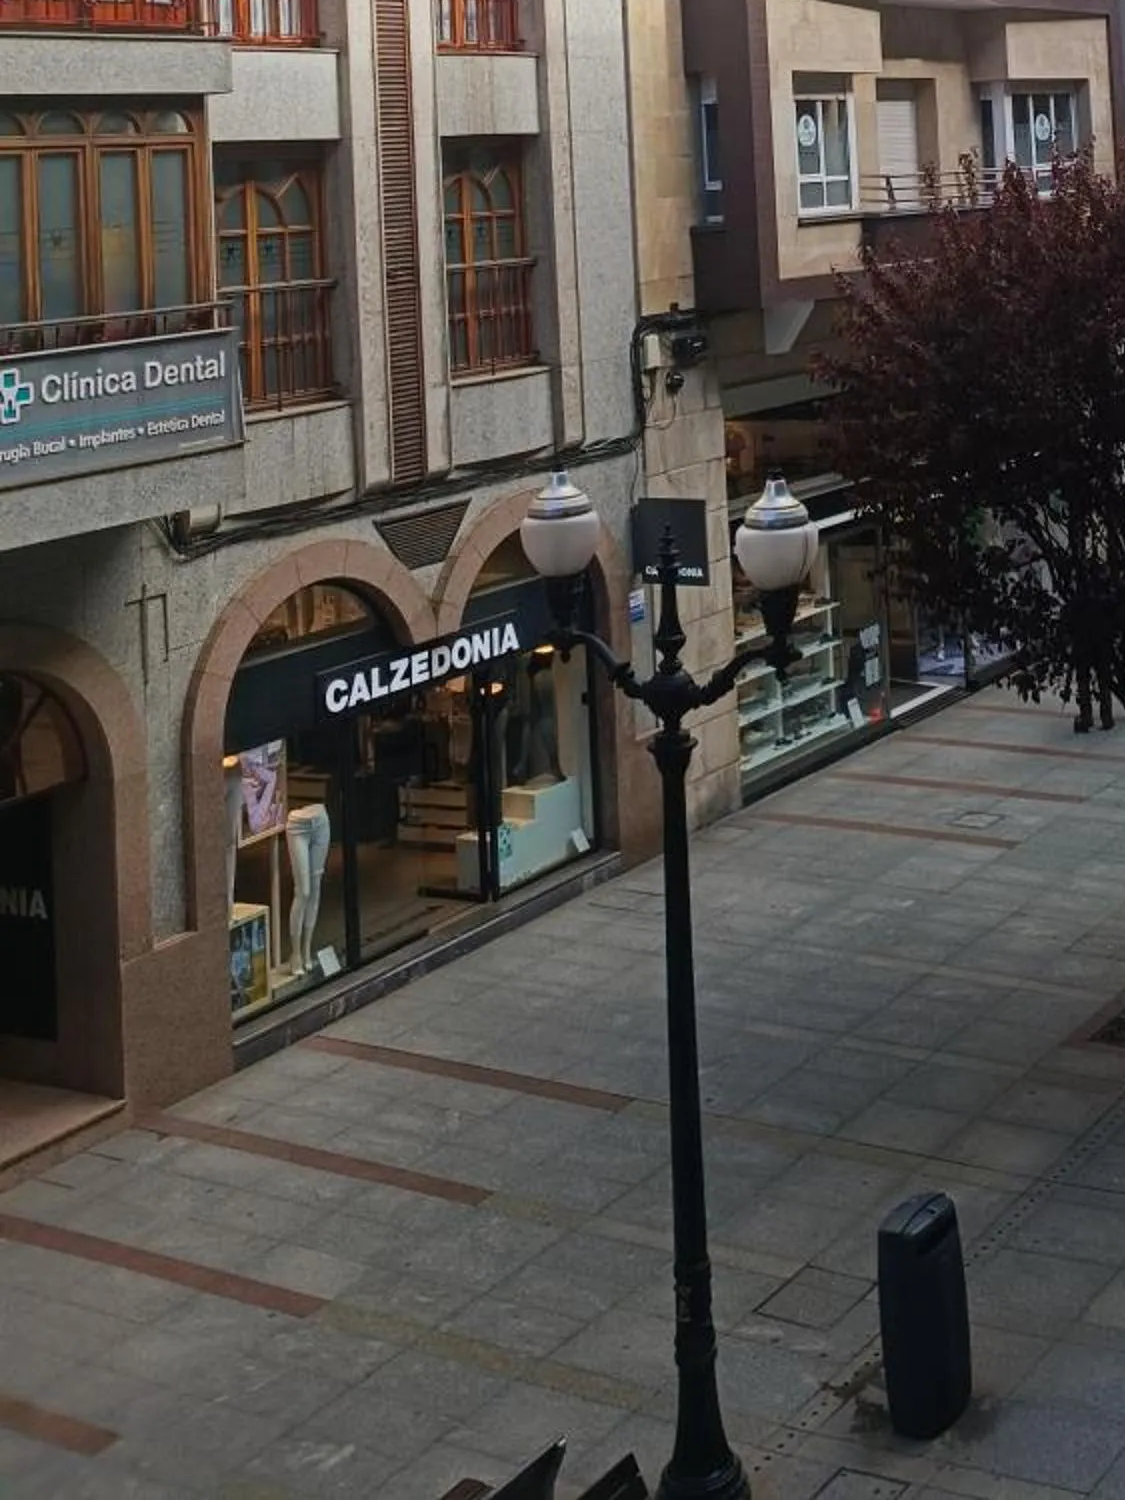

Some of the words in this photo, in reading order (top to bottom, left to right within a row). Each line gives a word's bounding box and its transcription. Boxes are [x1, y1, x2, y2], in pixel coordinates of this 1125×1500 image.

[41, 367, 137, 403] Clínica
[144, 350, 225, 388] Dental
[79, 426, 136, 449] Implantes
[191, 409, 225, 429] Dental
[325, 622, 520, 714] CALZEDONIA
